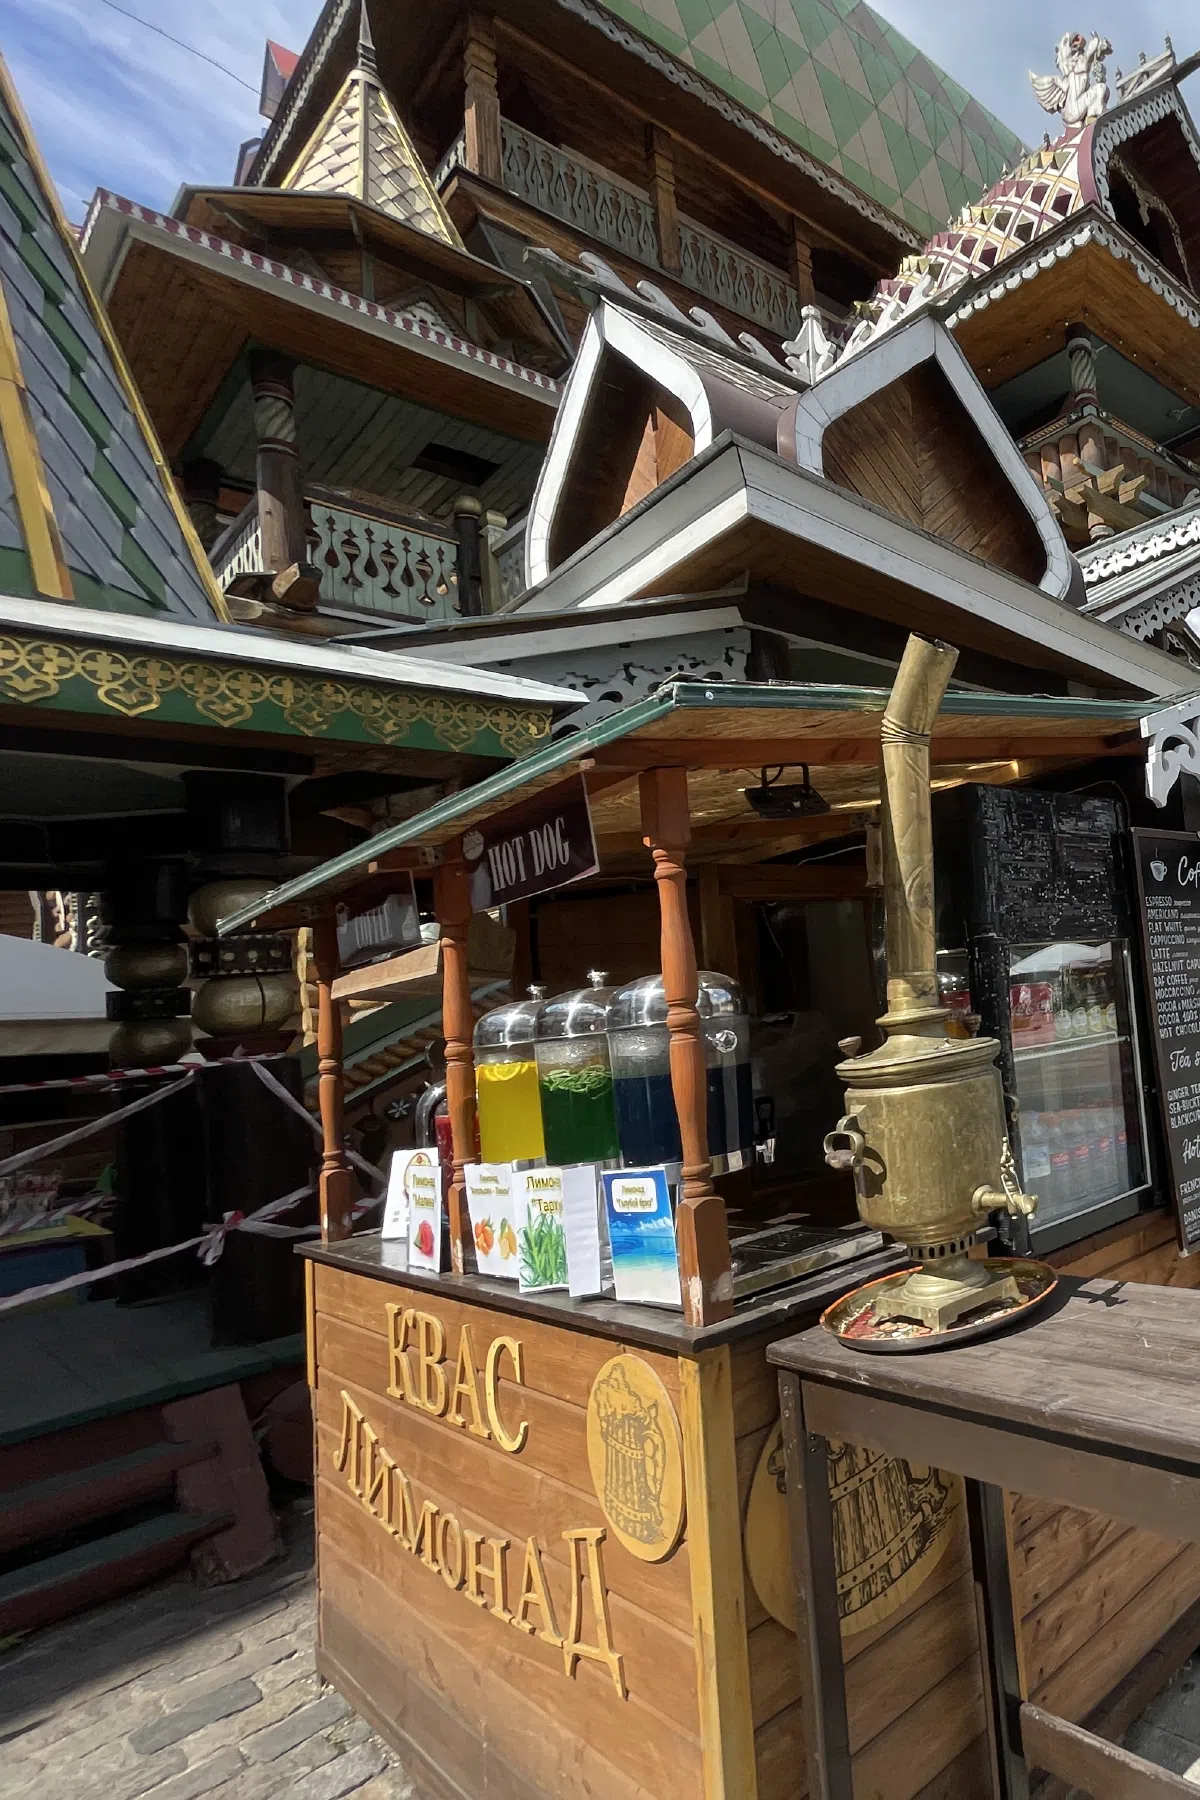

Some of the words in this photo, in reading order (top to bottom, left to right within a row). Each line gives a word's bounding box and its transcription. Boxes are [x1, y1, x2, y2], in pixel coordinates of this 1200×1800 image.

[487, 835, 527, 892] HOT
[529, 816, 571, 877] DOG
[1145, 896, 1173, 907] ESPRESSO
[1147, 909, 1179, 920] AMERICANO
[1148, 922, 1162, 933] FLAT
[1163, 921, 1183, 932] WHITE
[1150, 933, 1185, 946] CAPPUCCINO
[1150, 947, 1170, 960] LATTE
[1152, 960, 1184, 974] HAZELNUT
[1153, 975, 1165, 988] RAF
[1167, 973, 1188, 985] COFFEE
[1157, 1000, 1177, 1013] COCOA
[1158, 1013, 1180, 1026] COCOA
[1159, 1026, 1173, 1039] HOT
[1169, 1047, 1192, 1072] Tea
[1167, 1086, 1189, 1101] GINGER
[385, 1302, 529, 1452] КВАС
[332, 1389, 629, 1701] ЛИМОНАД
